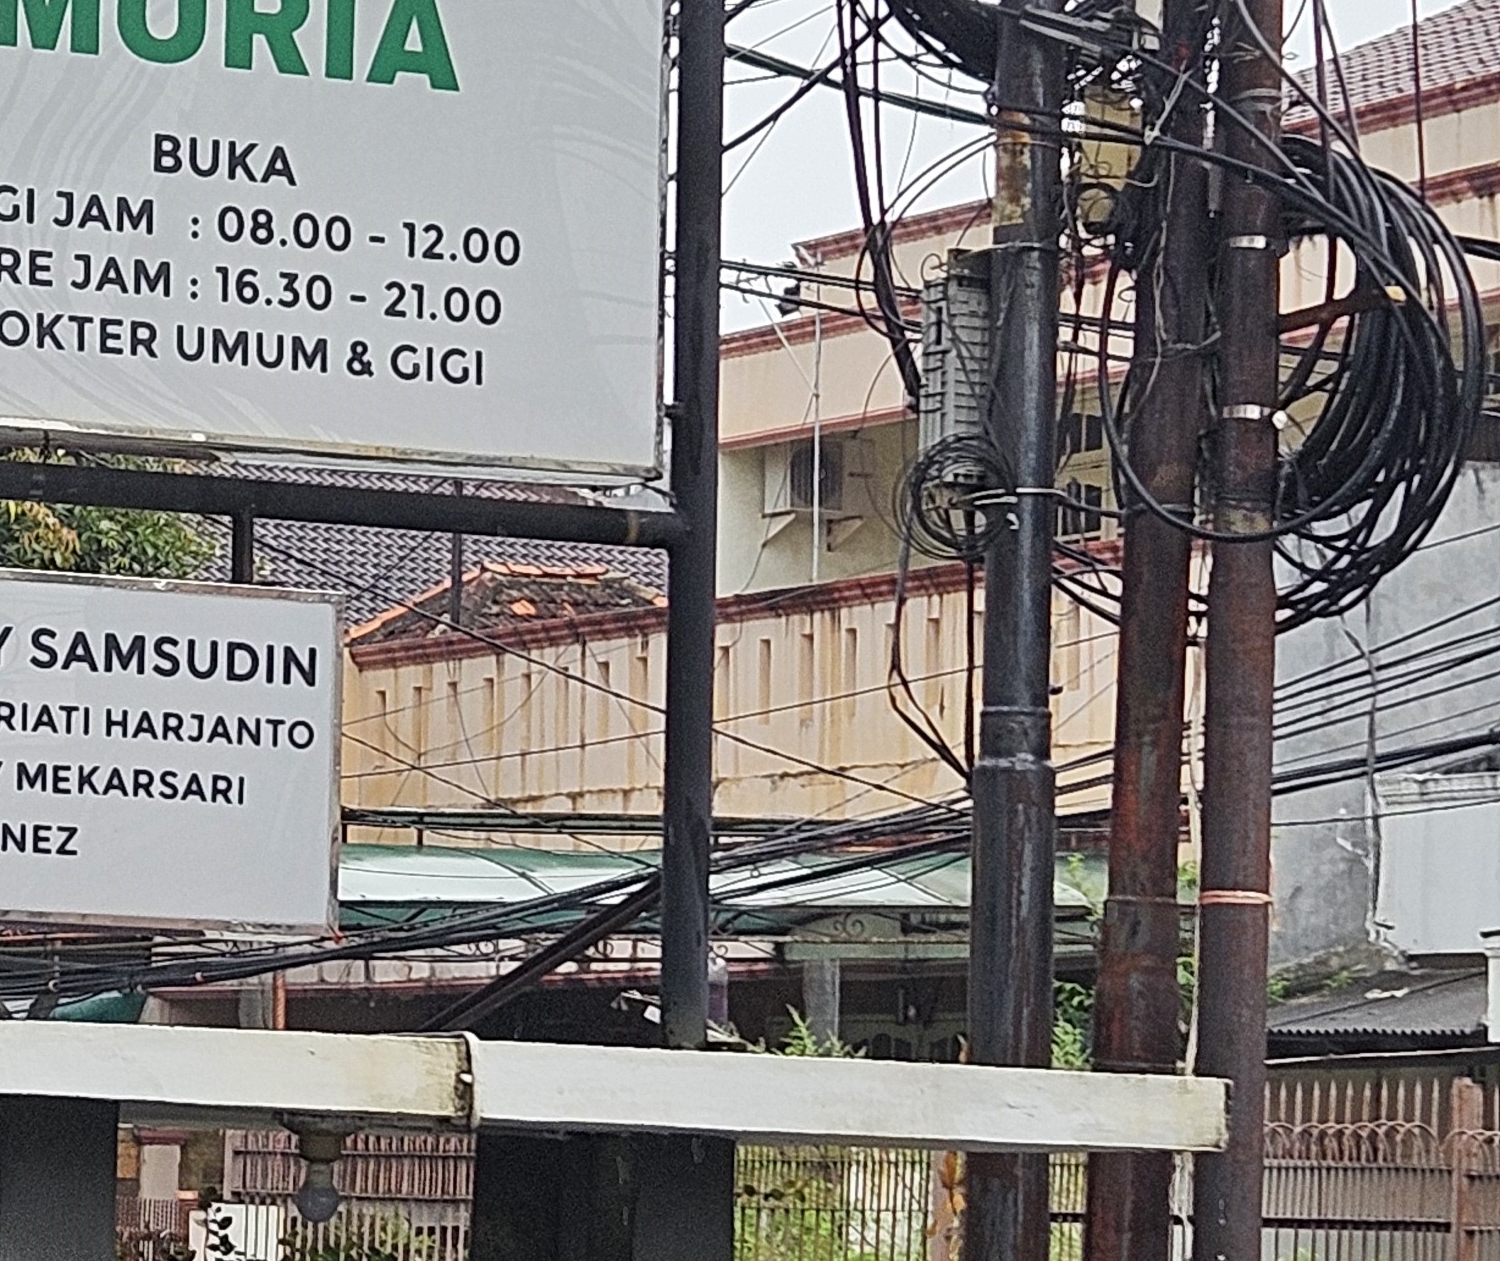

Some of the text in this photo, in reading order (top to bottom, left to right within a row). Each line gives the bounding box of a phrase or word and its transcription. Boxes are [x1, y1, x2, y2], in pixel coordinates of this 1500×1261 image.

[153, 133, 297, 187] BUKA
[52, 190, 154, 236] JAM
[217, 205, 352, 252] 08.00
[402, 221, 521, 267] 12.00
[70, 253, 171, 298] JAM
[215, 266, 332, 311] 16.30
[383, 280, 502, 326] 21.00
[176, 324, 328, 374] UMUM
[346, 340, 375, 378] &
[390, 344, 483, 386] GIGI
[29, 627, 317, 688] SAMSUDIN
[105, 708, 315, 750] HARJANTO
[16, 761, 245, 806] MEKARSARI
